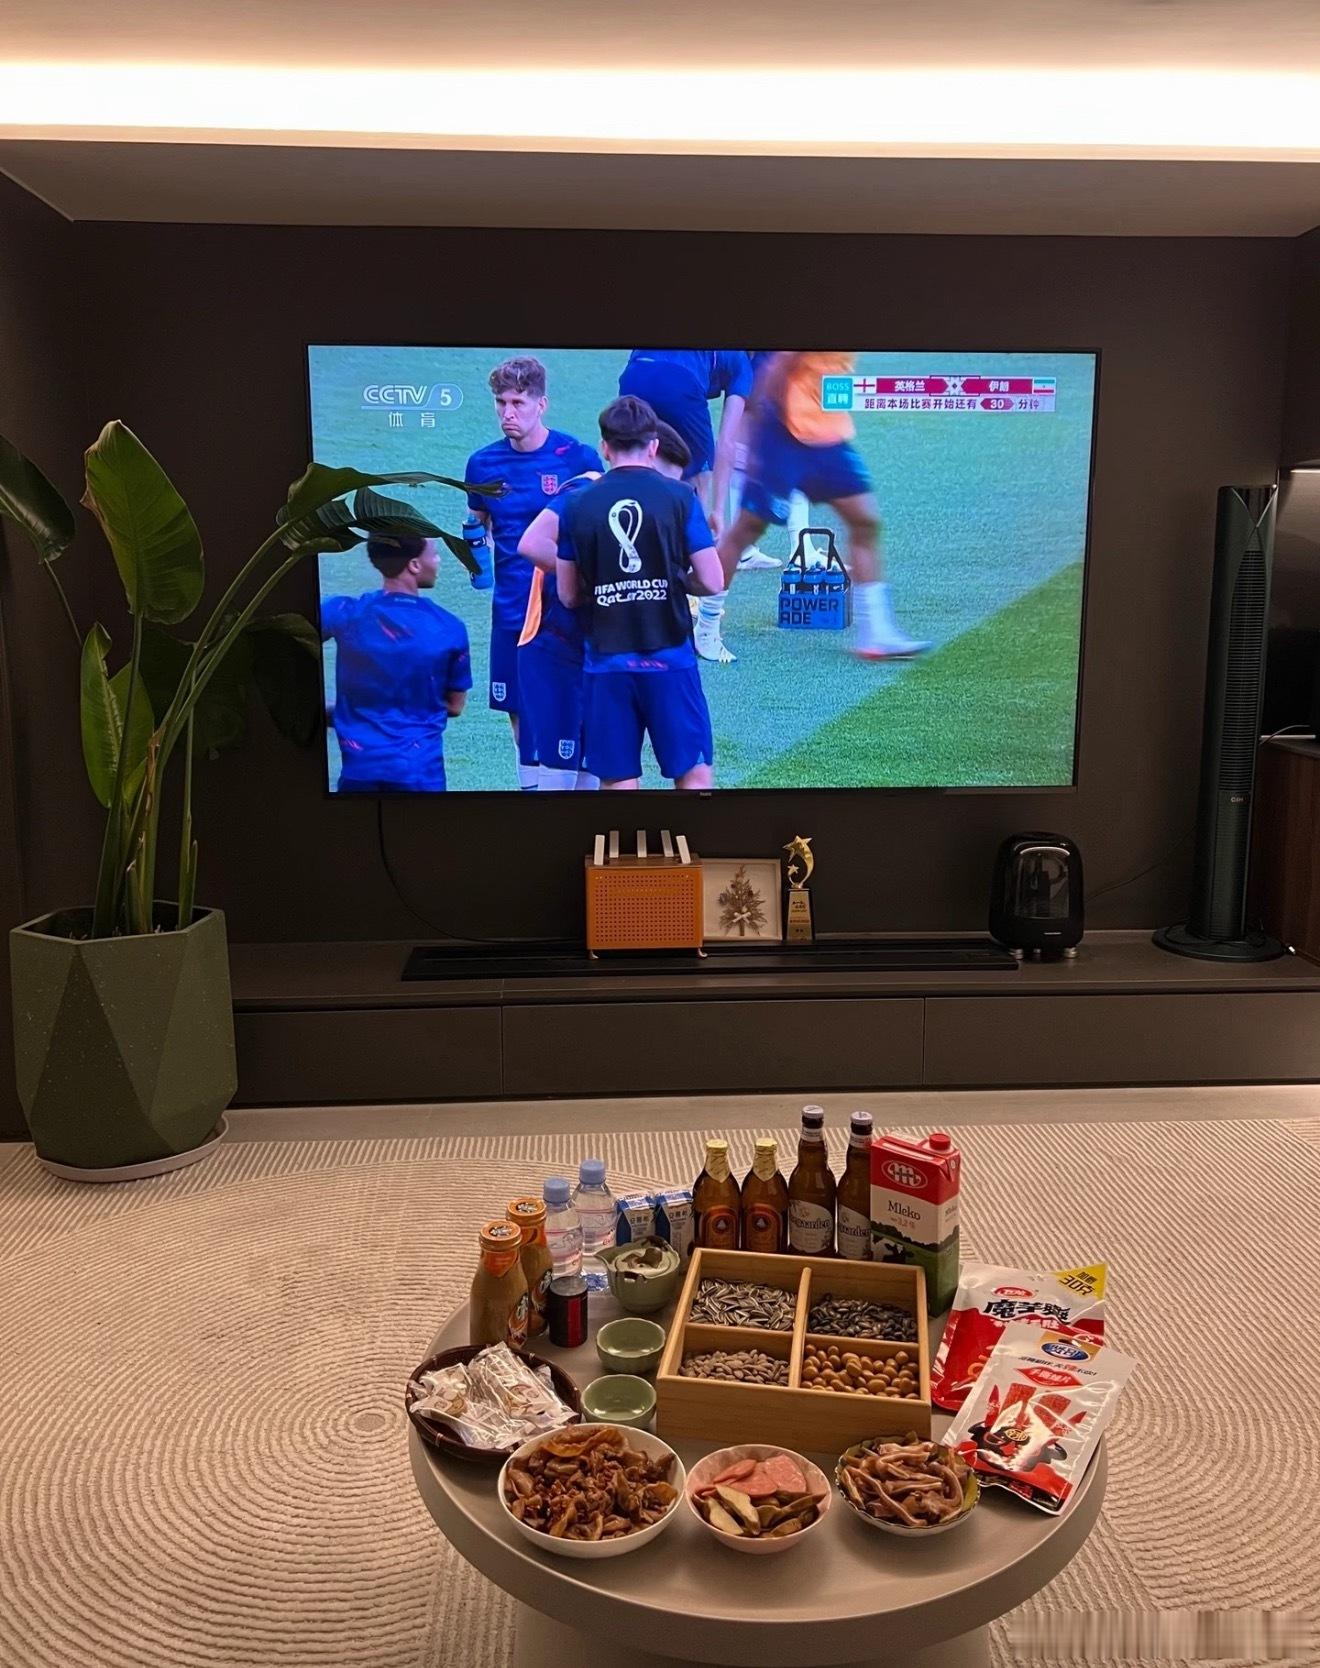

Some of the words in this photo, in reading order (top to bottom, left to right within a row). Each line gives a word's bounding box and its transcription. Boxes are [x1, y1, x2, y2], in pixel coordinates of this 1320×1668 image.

[826, 382, 850, 391] BOSS
[894, 380, 926, 392] 英格兰
[363, 384, 427, 404] CCTV
[440, 388, 452, 406] 5
[864, 398, 977, 410] 距离本场比赛开始还有
[990, 399, 1005, 409] 30
[615, 580, 651, 592] WORLD
[780, 597, 839, 612] POWER
[780, 611, 812, 625] ADE
[888, 1199, 921, 1220] Mleko
[1058, 1274, 1097, 1296] 30克
